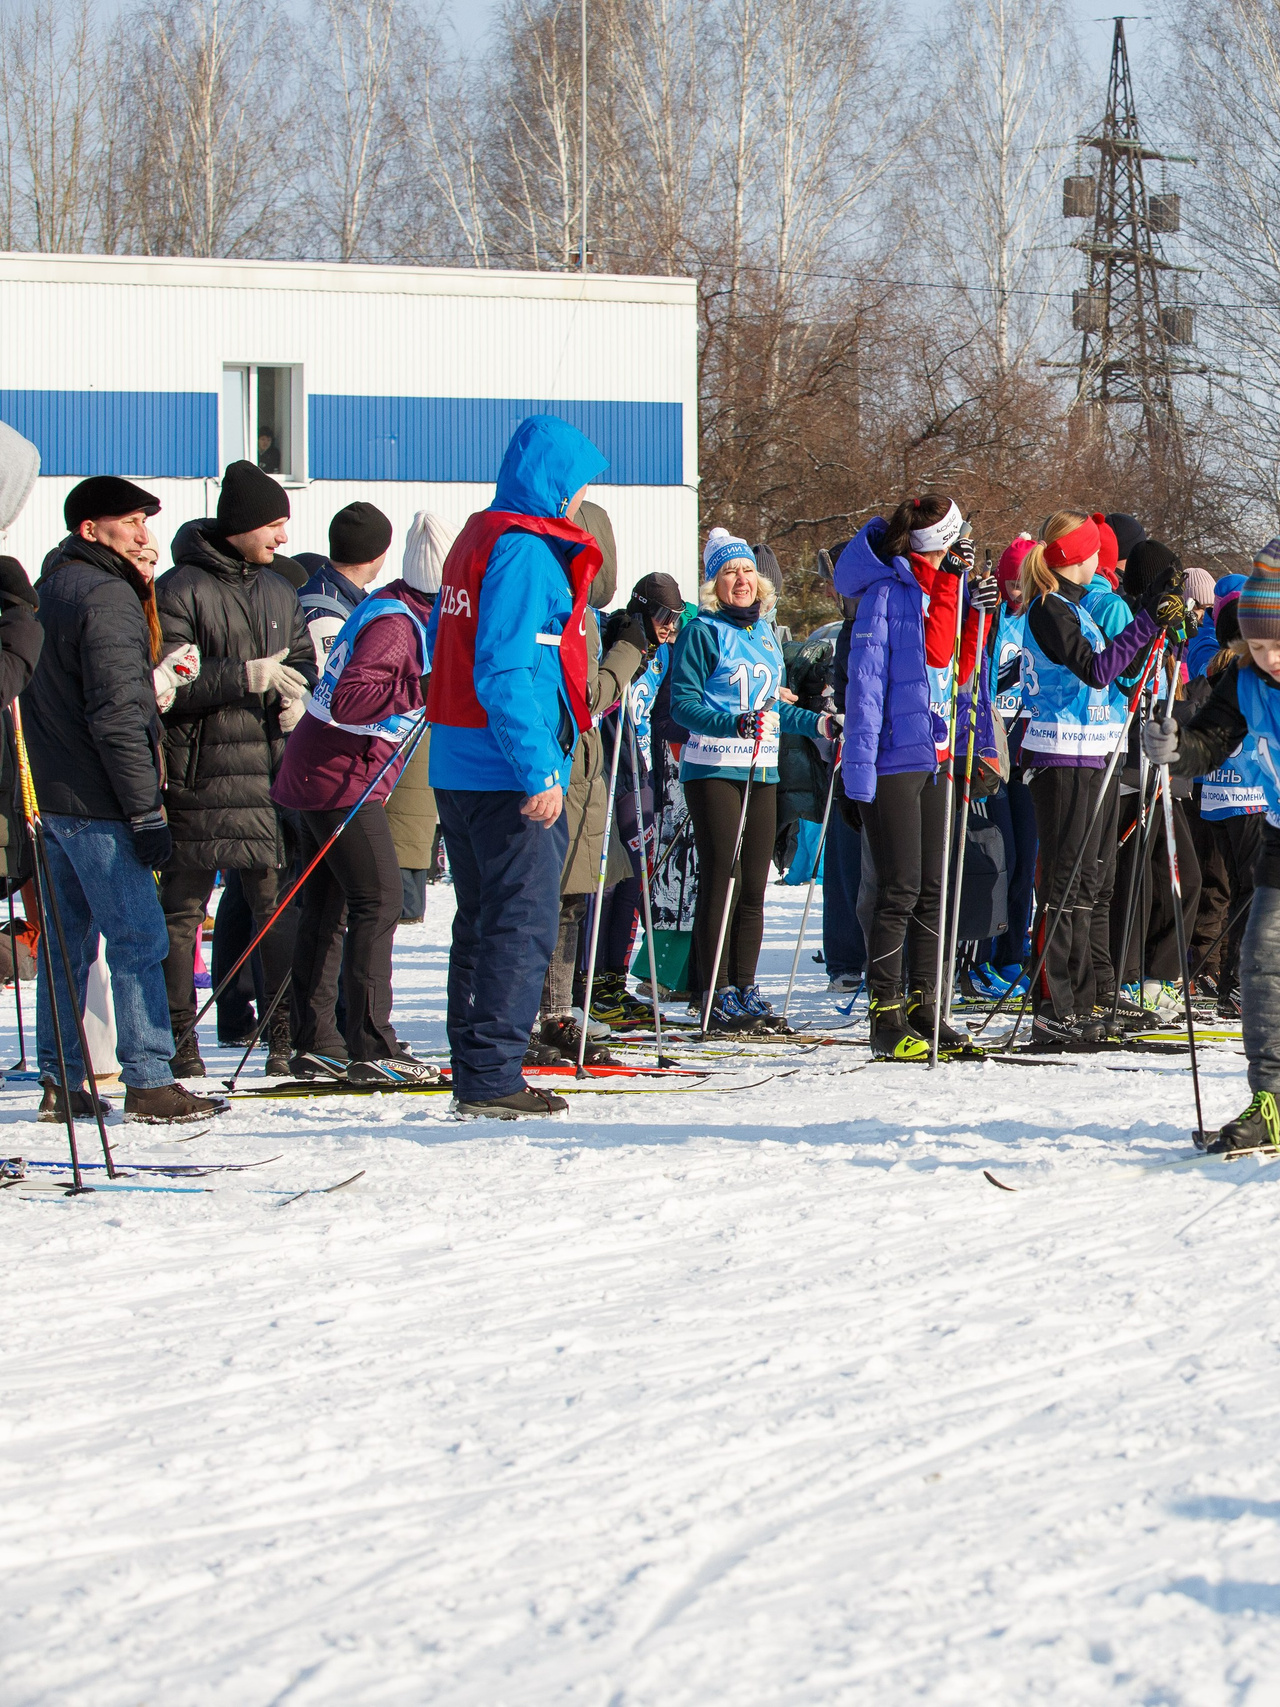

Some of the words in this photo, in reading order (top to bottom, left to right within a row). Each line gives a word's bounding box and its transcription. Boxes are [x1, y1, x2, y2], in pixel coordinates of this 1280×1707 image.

[709, 546, 743, 571] РОССИИ
[441, 585, 472, 618] ДЬЯ
[1062, 731, 1088, 741] КУБОК
[702, 745, 731, 754] КУБОК
[733, 746, 753, 754] ГЛАВ
[761, 746, 779, 754] ГОРО
[1205, 768, 1242, 784] МЕНЬ
[1232, 792, 1265, 801] ТЮМЕНИ
